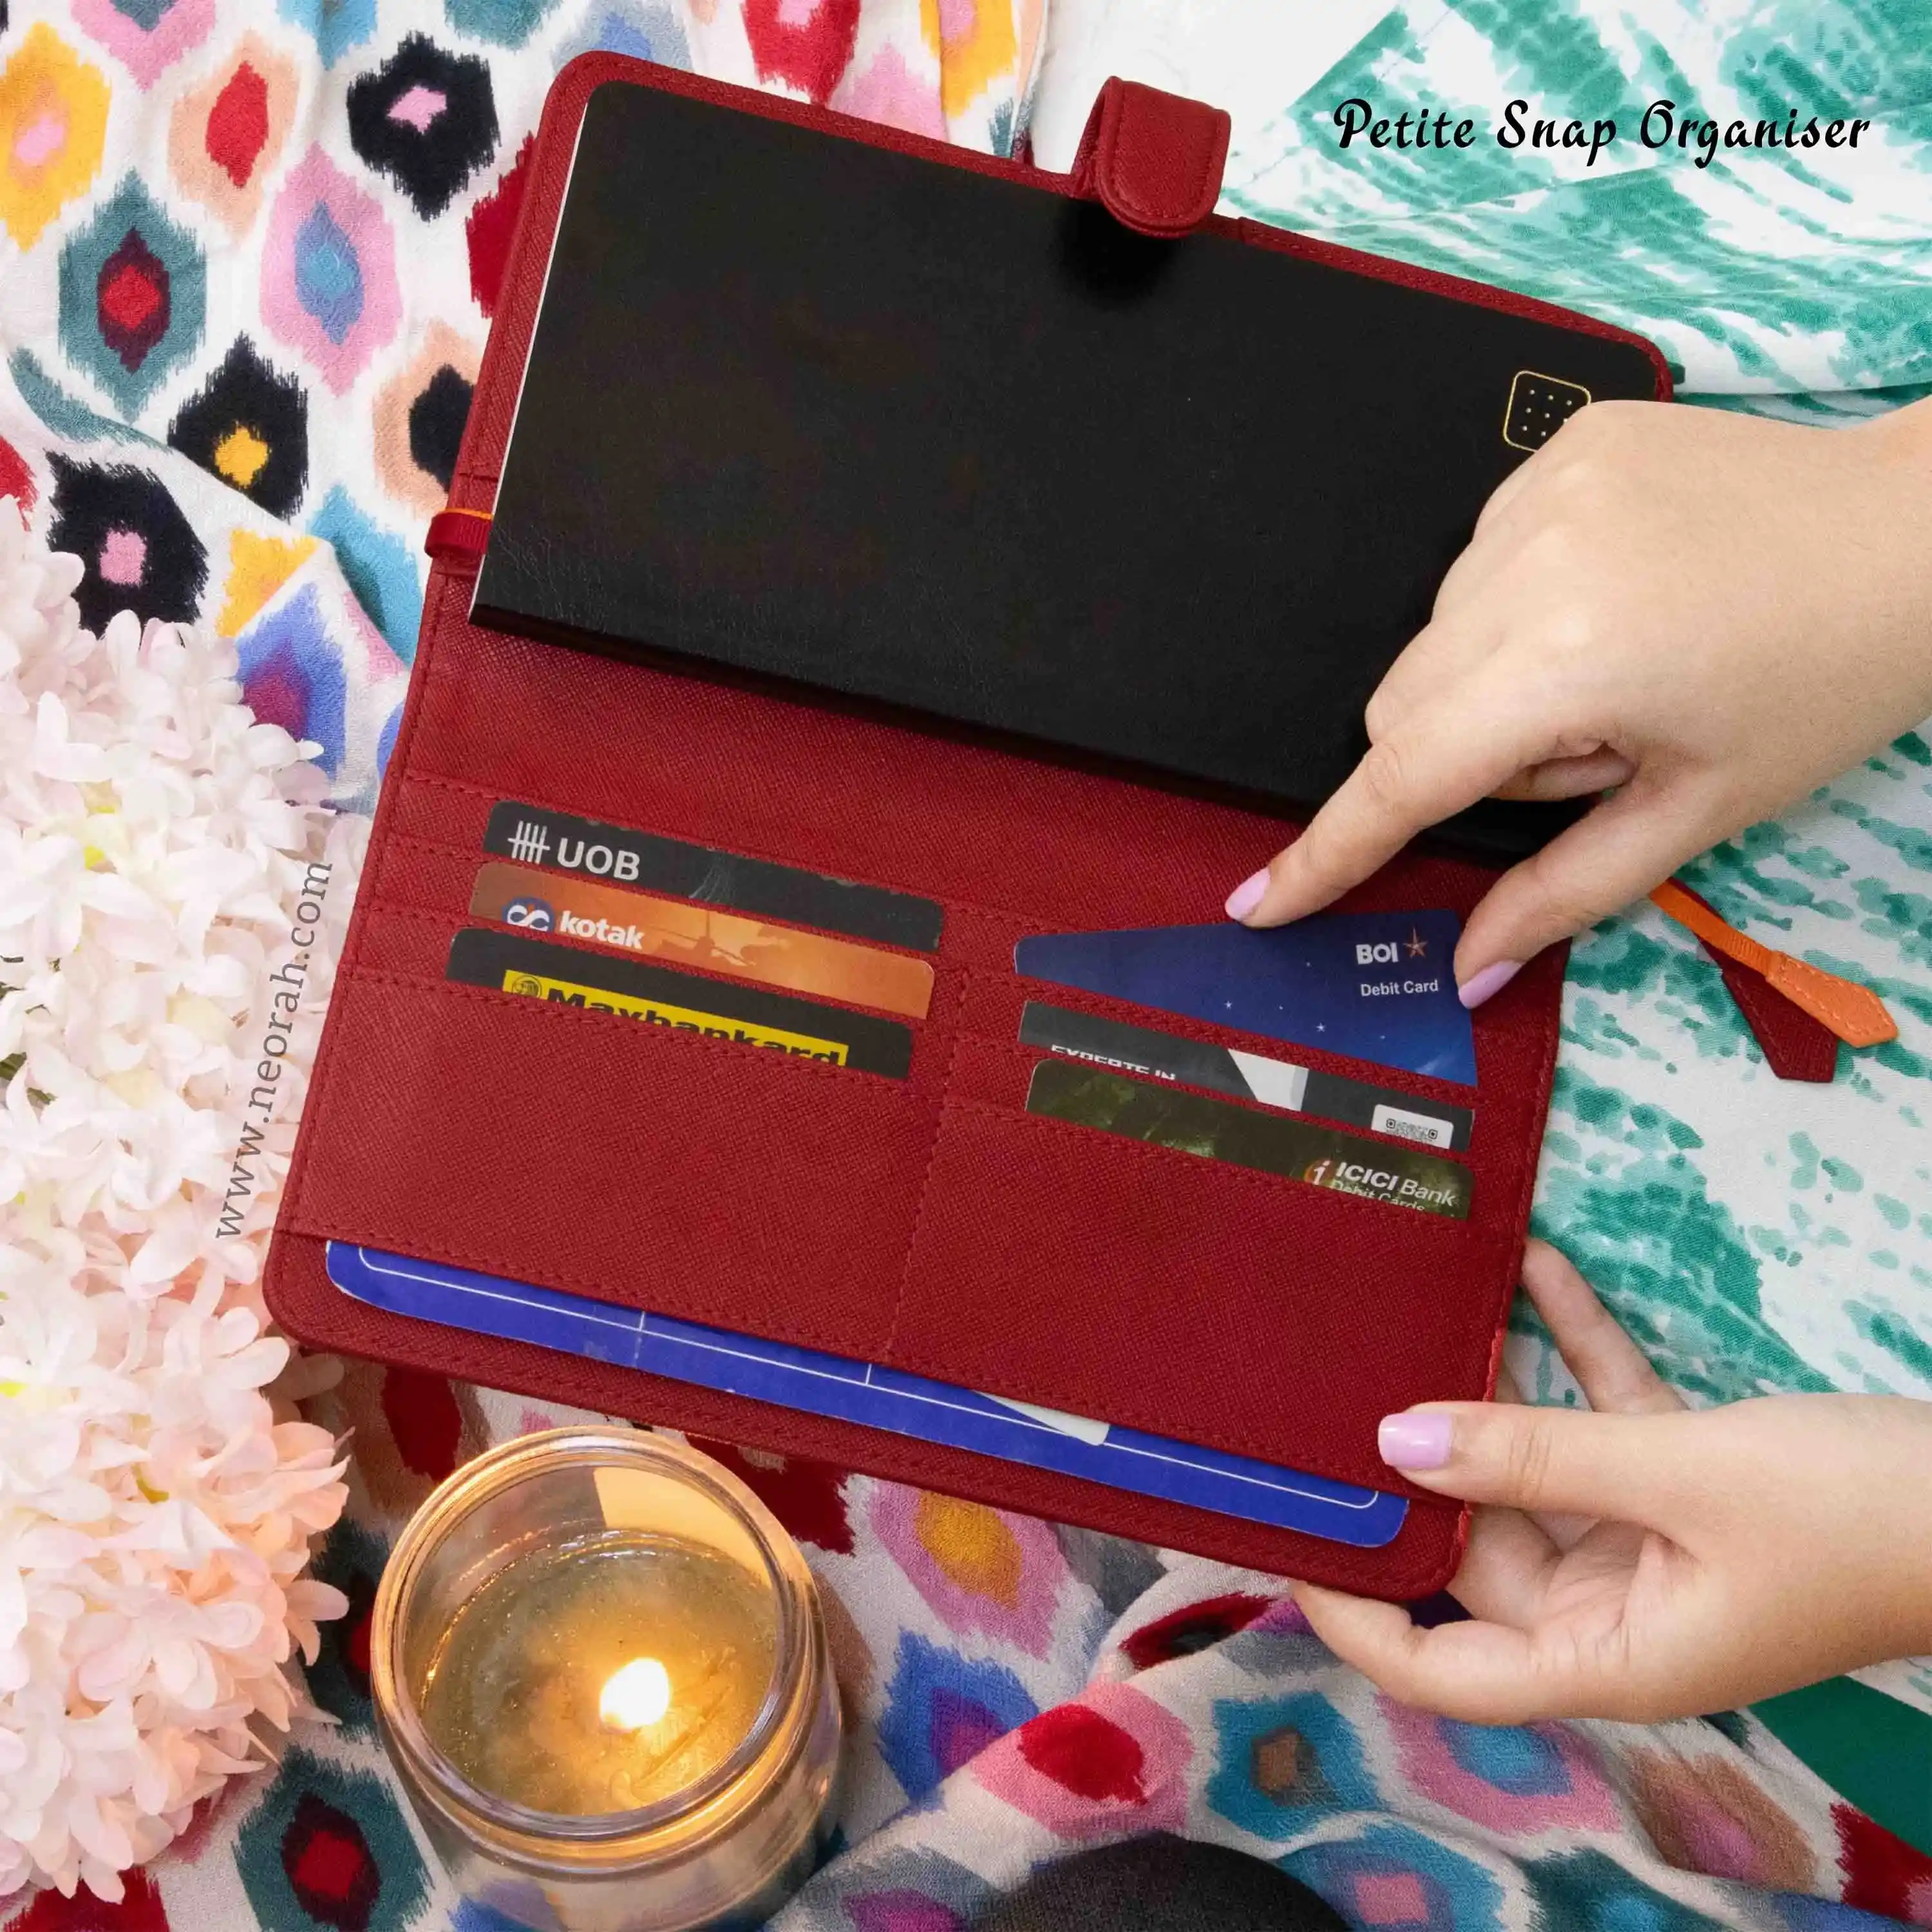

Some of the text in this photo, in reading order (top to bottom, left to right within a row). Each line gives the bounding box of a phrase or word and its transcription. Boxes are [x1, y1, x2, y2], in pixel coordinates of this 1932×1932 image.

[557, 838, 640, 881] UOB
[560, 910, 645, 949] kotak
[1356, 942, 1399, 965] BOI
[1360, 978, 1439, 997] Debit Card
[1336, 1162, 1399, 1191] ICICI
[1399, 1179, 1456, 1207] Bank
